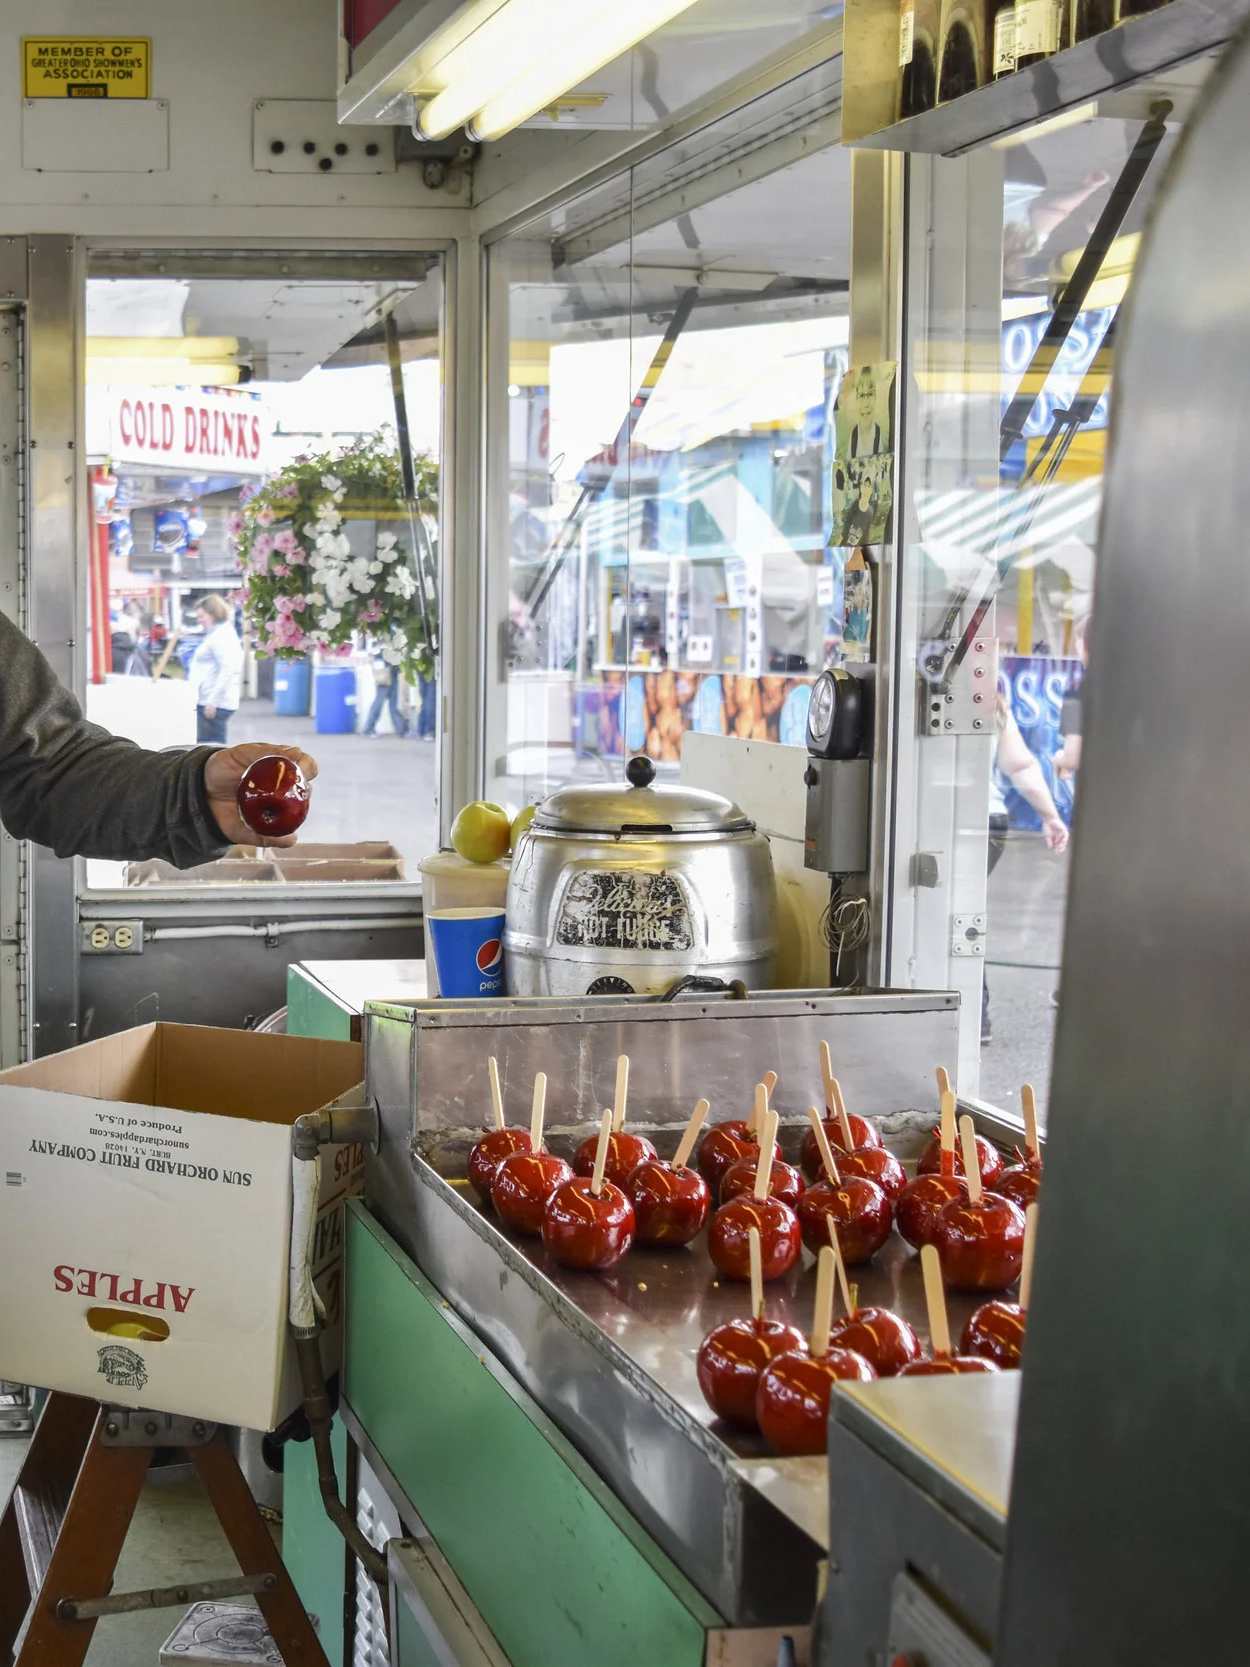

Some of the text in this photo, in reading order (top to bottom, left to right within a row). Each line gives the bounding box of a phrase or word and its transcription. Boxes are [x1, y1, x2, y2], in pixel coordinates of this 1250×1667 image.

[38, 46, 133, 57] MEMBER OF
[32, 59, 70, 68] GREATER
[70, 58, 91, 68] OHIO
[43, 69, 134, 79] ASSOCIATION
[119, 399, 261, 460] COLD DRINKS
[95, 1113, 182, 1134] Produce of U.S.A.
[90, 1128, 190, 1150] sunorchardapples.com
[29, 1139, 253, 1187] SUN ORCHARD FRUIT COMPANY
[53, 1265, 196, 1313] APPLES
